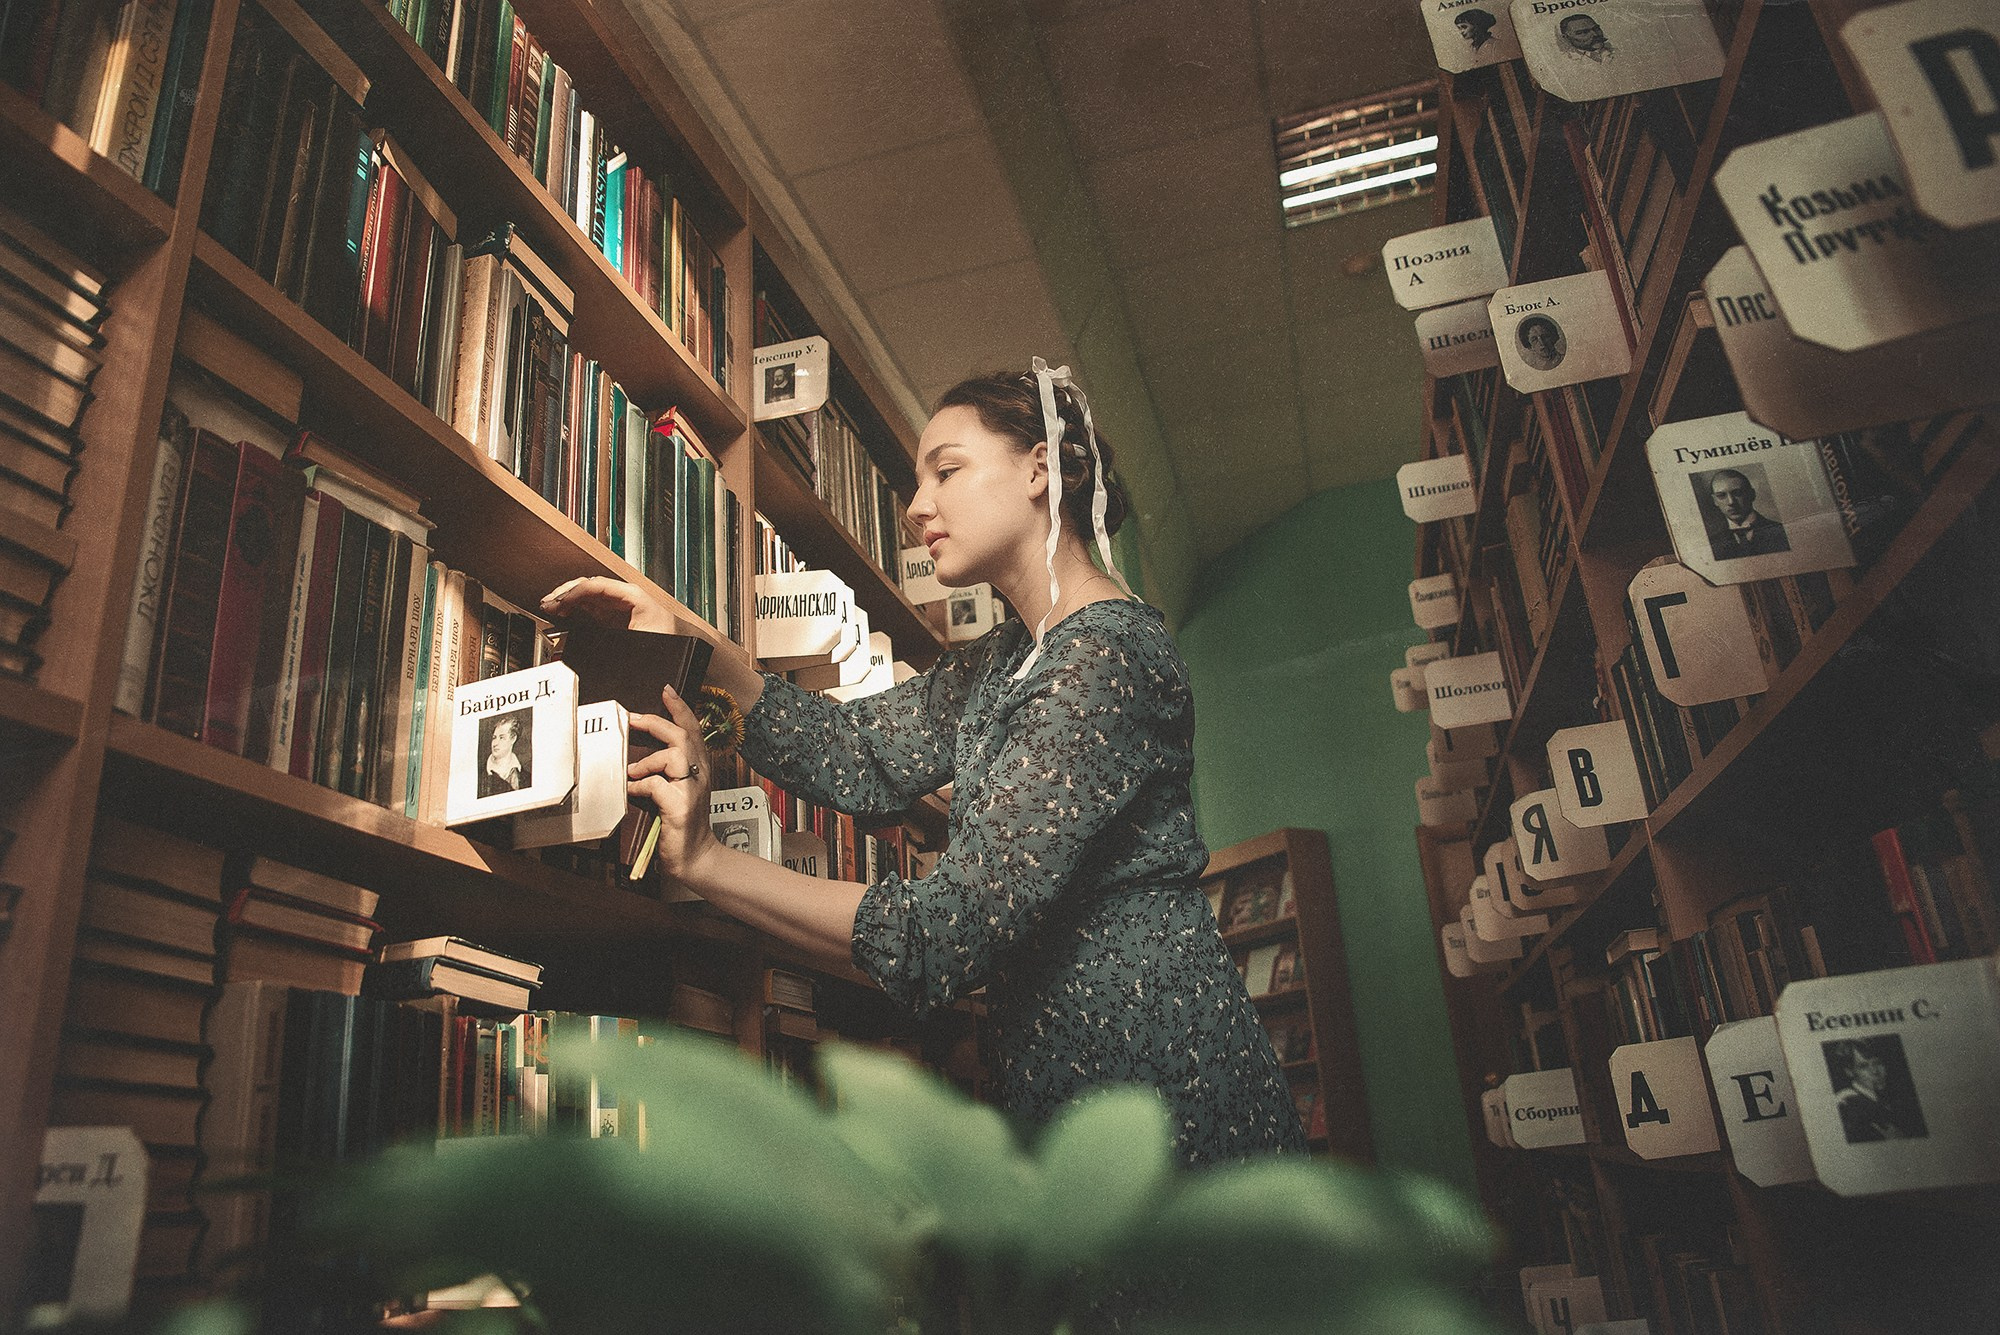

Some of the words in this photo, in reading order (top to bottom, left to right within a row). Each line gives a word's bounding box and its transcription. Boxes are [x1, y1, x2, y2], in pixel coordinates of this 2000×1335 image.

[1908, 28, 2000, 172] Р
[592, 154, 608, 248] ULYSSES
[1393, 243, 1471, 271] Поэзия
[1408, 272, 1425, 287] А
[1504, 299, 1542, 316] Блок
[1545, 295, 1561, 309] А.
[806, 344, 818, 356] У.
[1674, 436, 1772, 465] Гумилёв
[1407, 480, 1470, 500] Шишко
[755, 592, 836, 619] АФРИКАНСКАЯ
[407, 624, 419, 679] БЕРНАРД
[413, 594, 421, 622] ШОУ
[1644, 592, 1688, 679] Г
[432, 640, 441, 693] БЕРНАРД
[448, 648, 457, 701] БЕРНАРД
[460, 688, 530, 717] Байрон
[535, 680, 556, 699] Д.
[583, 716, 609, 735] Ш.
[1567, 748, 1603, 808] В
[742, 796, 759, 811] Э.
[1522, 803, 1559, 865] Я
[1806, 1003, 1905, 1033] Есенин
[1913, 998, 1940, 1021] С.
[1515, 1105, 1580, 1122] Сборни
[1626, 1071, 1671, 1129] Д
[1730, 1070, 1788, 1124] Е
